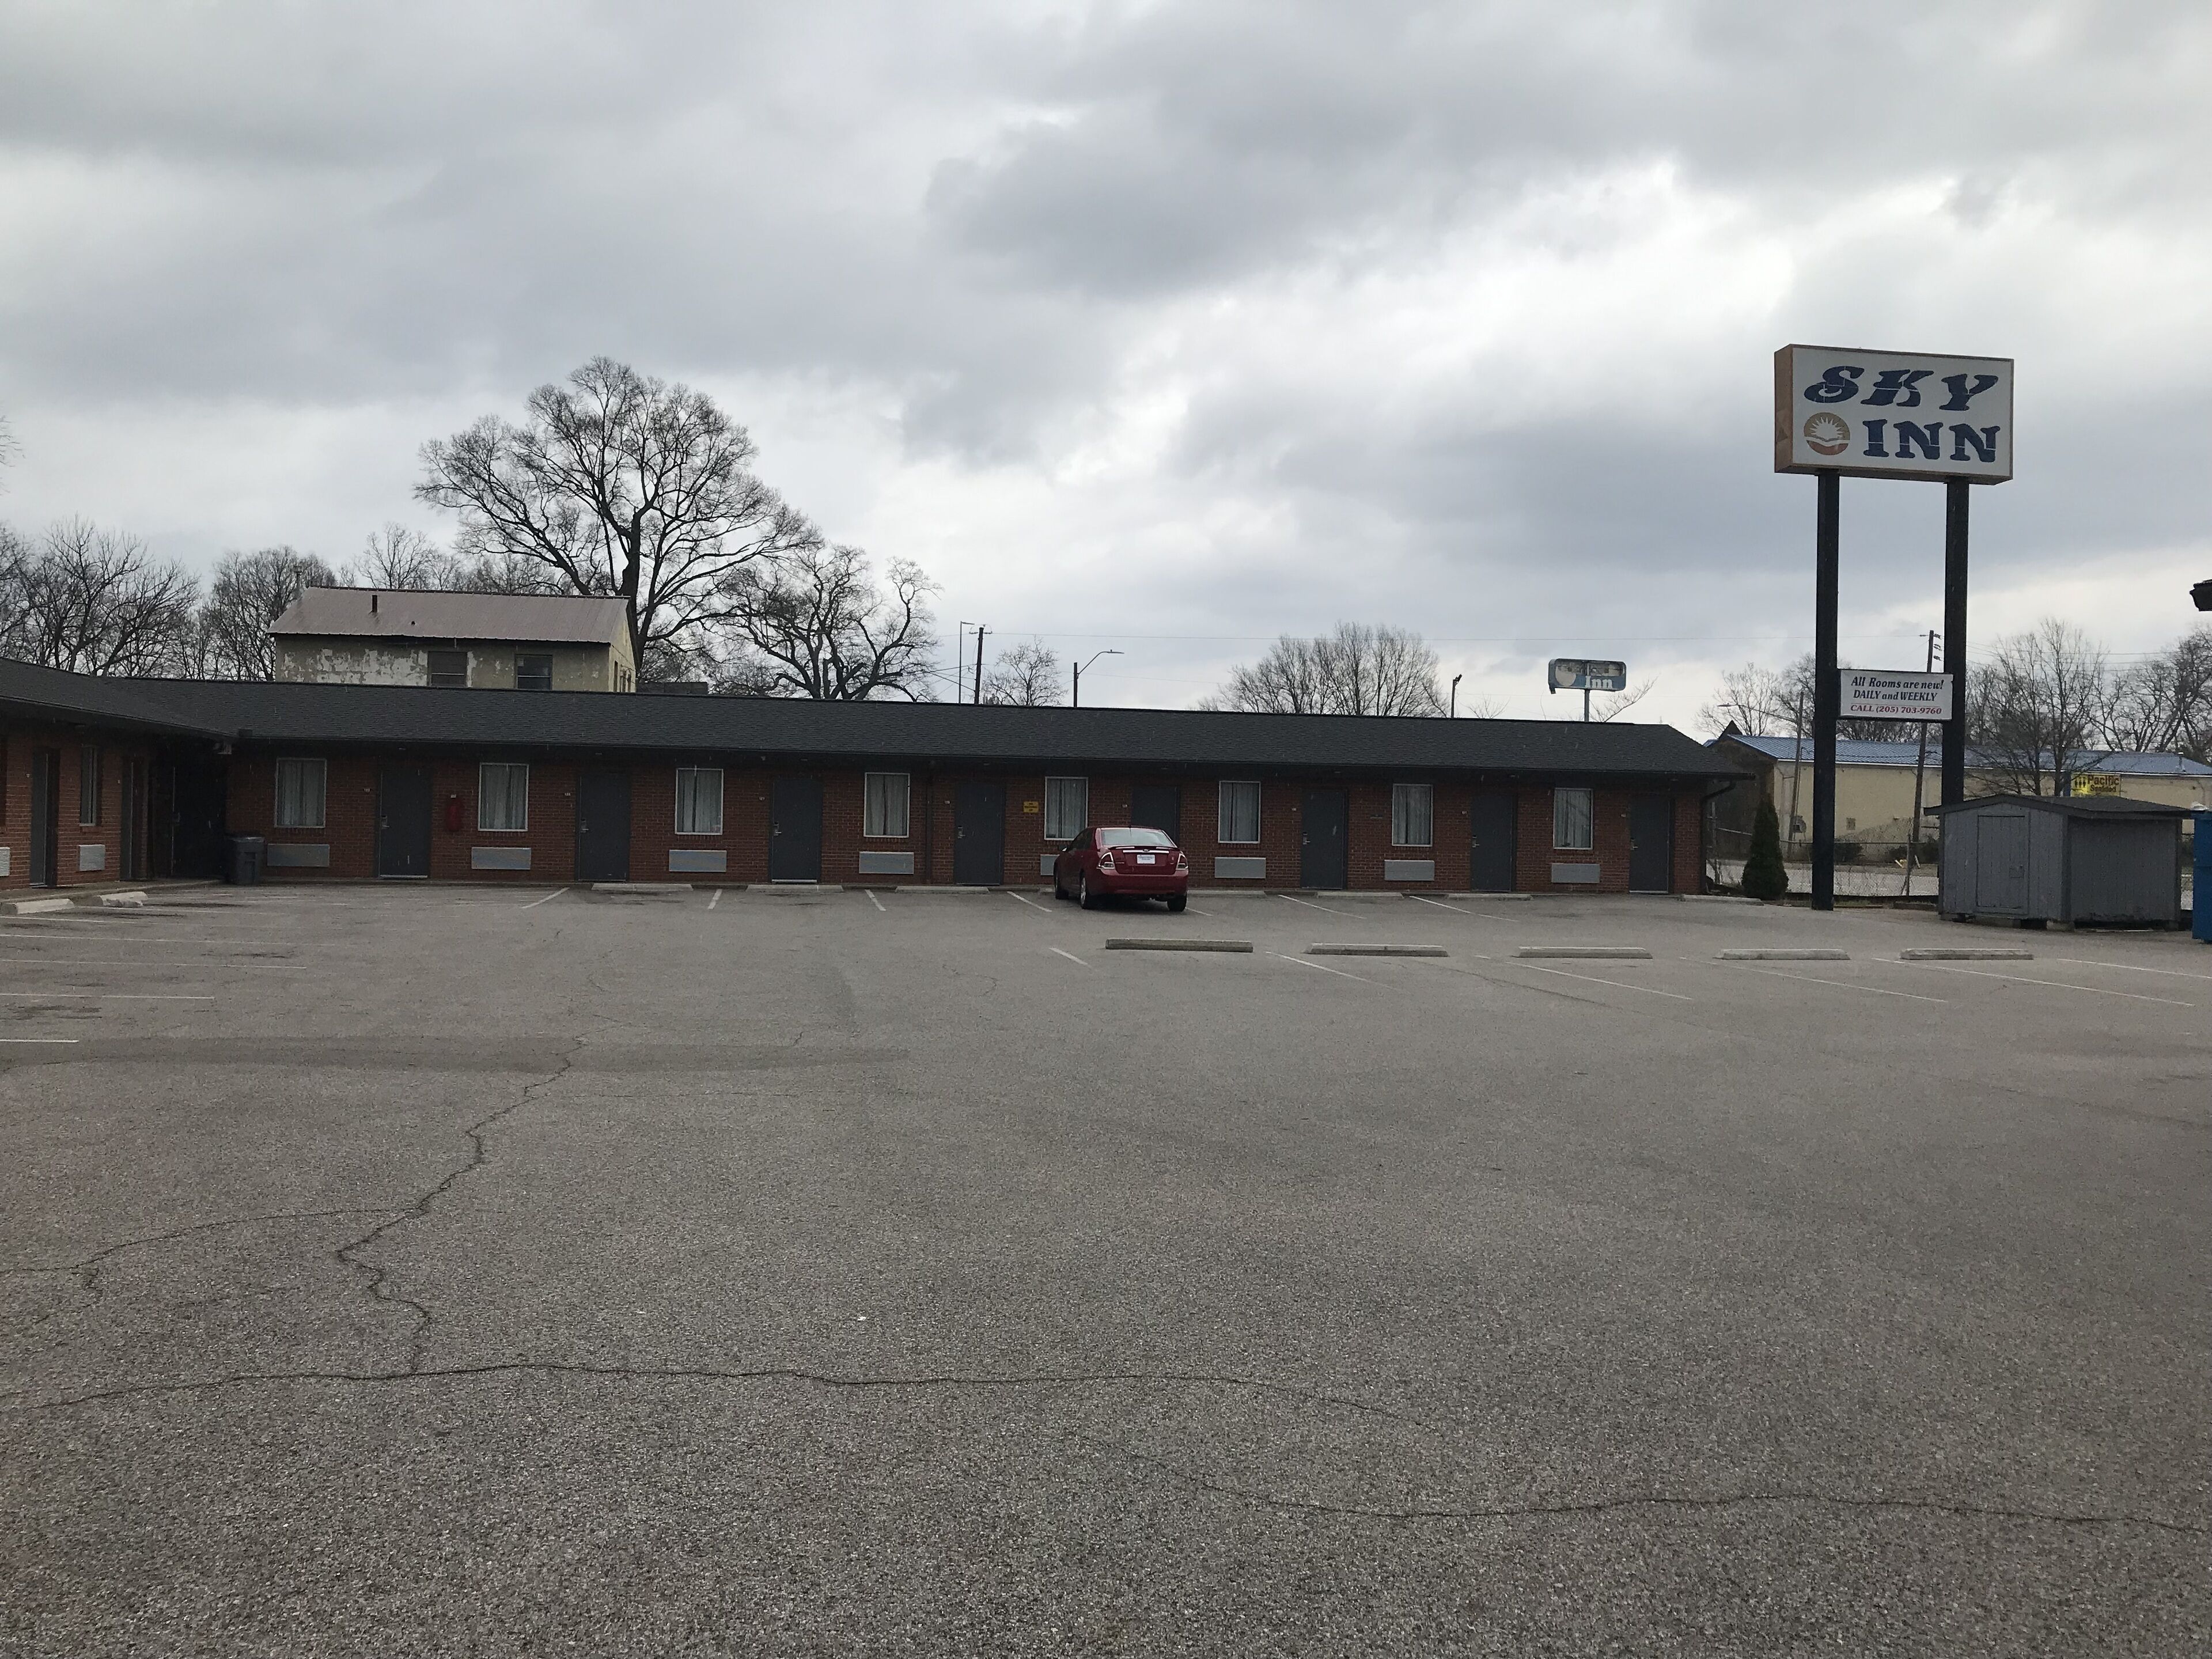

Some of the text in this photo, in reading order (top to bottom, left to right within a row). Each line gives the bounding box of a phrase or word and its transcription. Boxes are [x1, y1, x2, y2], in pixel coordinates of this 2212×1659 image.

[1804, 366, 1999, 411] SKY
[1862, 419, 2001, 463] INN
[1585, 675, 1613, 688] Inn
[1851, 676, 1944, 690] All Rooms are new!
[1853, 690, 1937, 702] DAILY and WEEKLY
[1850, 704, 1942, 715] CALL (205) 703-9760
[2088, 774, 2119, 785] Pacific
